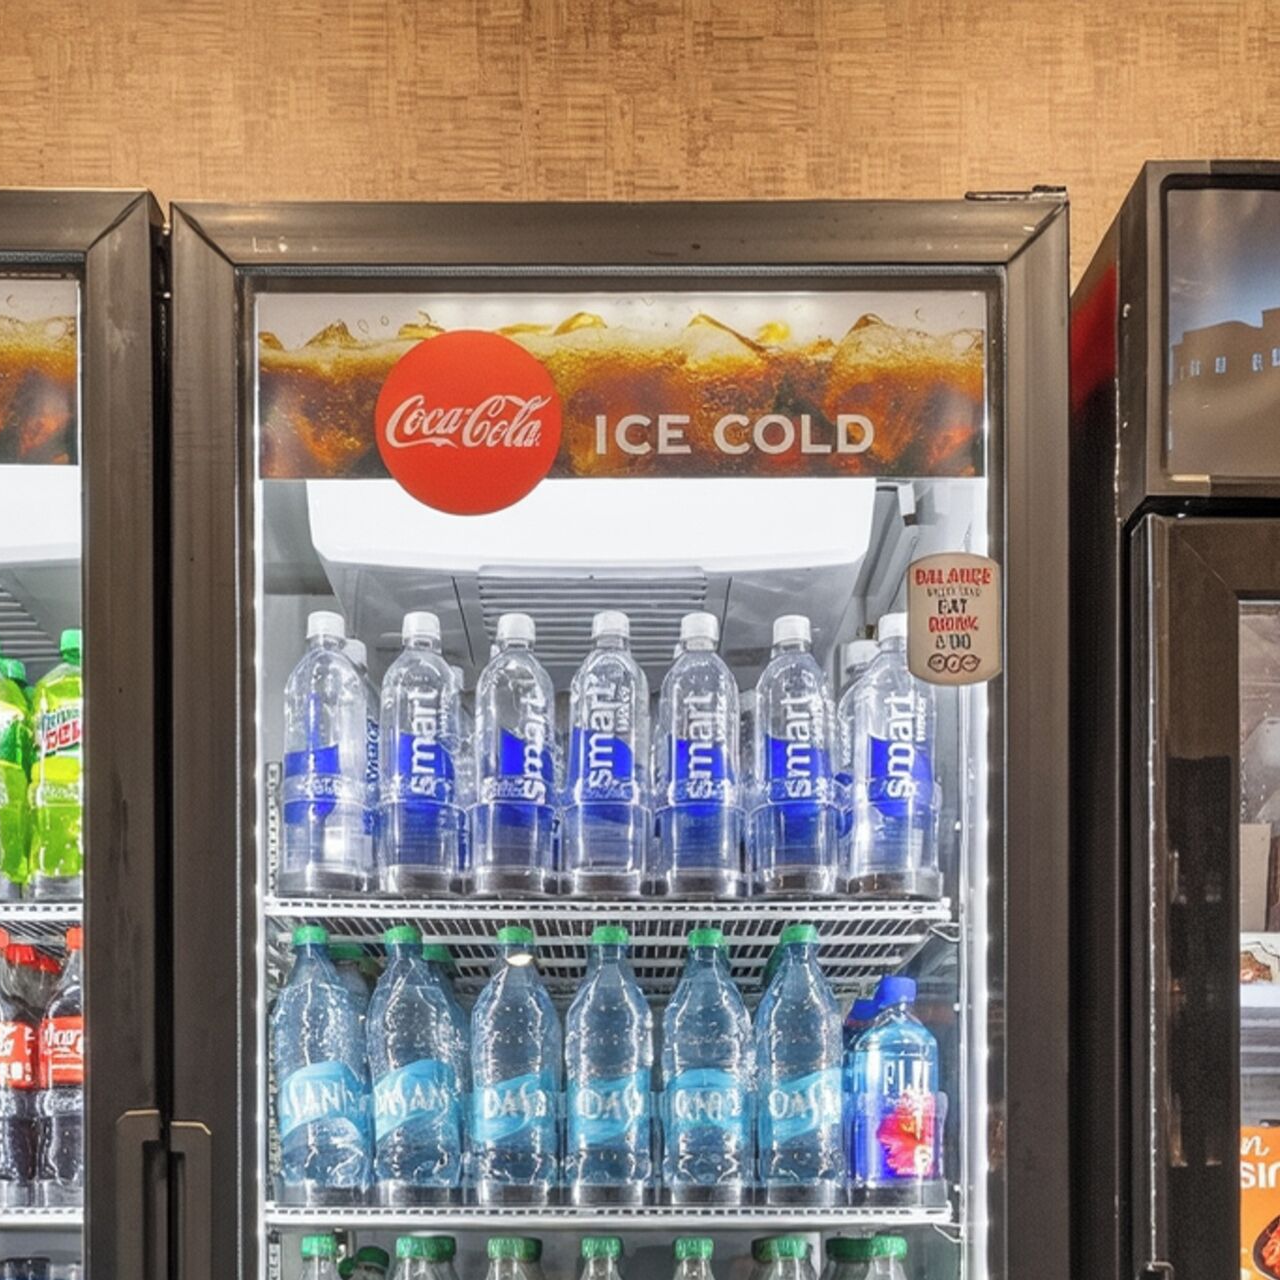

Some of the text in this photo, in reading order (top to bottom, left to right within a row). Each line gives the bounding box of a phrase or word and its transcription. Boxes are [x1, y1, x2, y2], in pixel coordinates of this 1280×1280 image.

[384, 393, 551, 449] Coca-Cola
[596, 413, 875, 455] ICE COLD
[407, 687, 438, 798] smart
[585, 681, 617, 788] smart
[683, 690, 715, 799] smart
[780, 692, 813, 799] smart
[884, 690, 915, 798] smart
